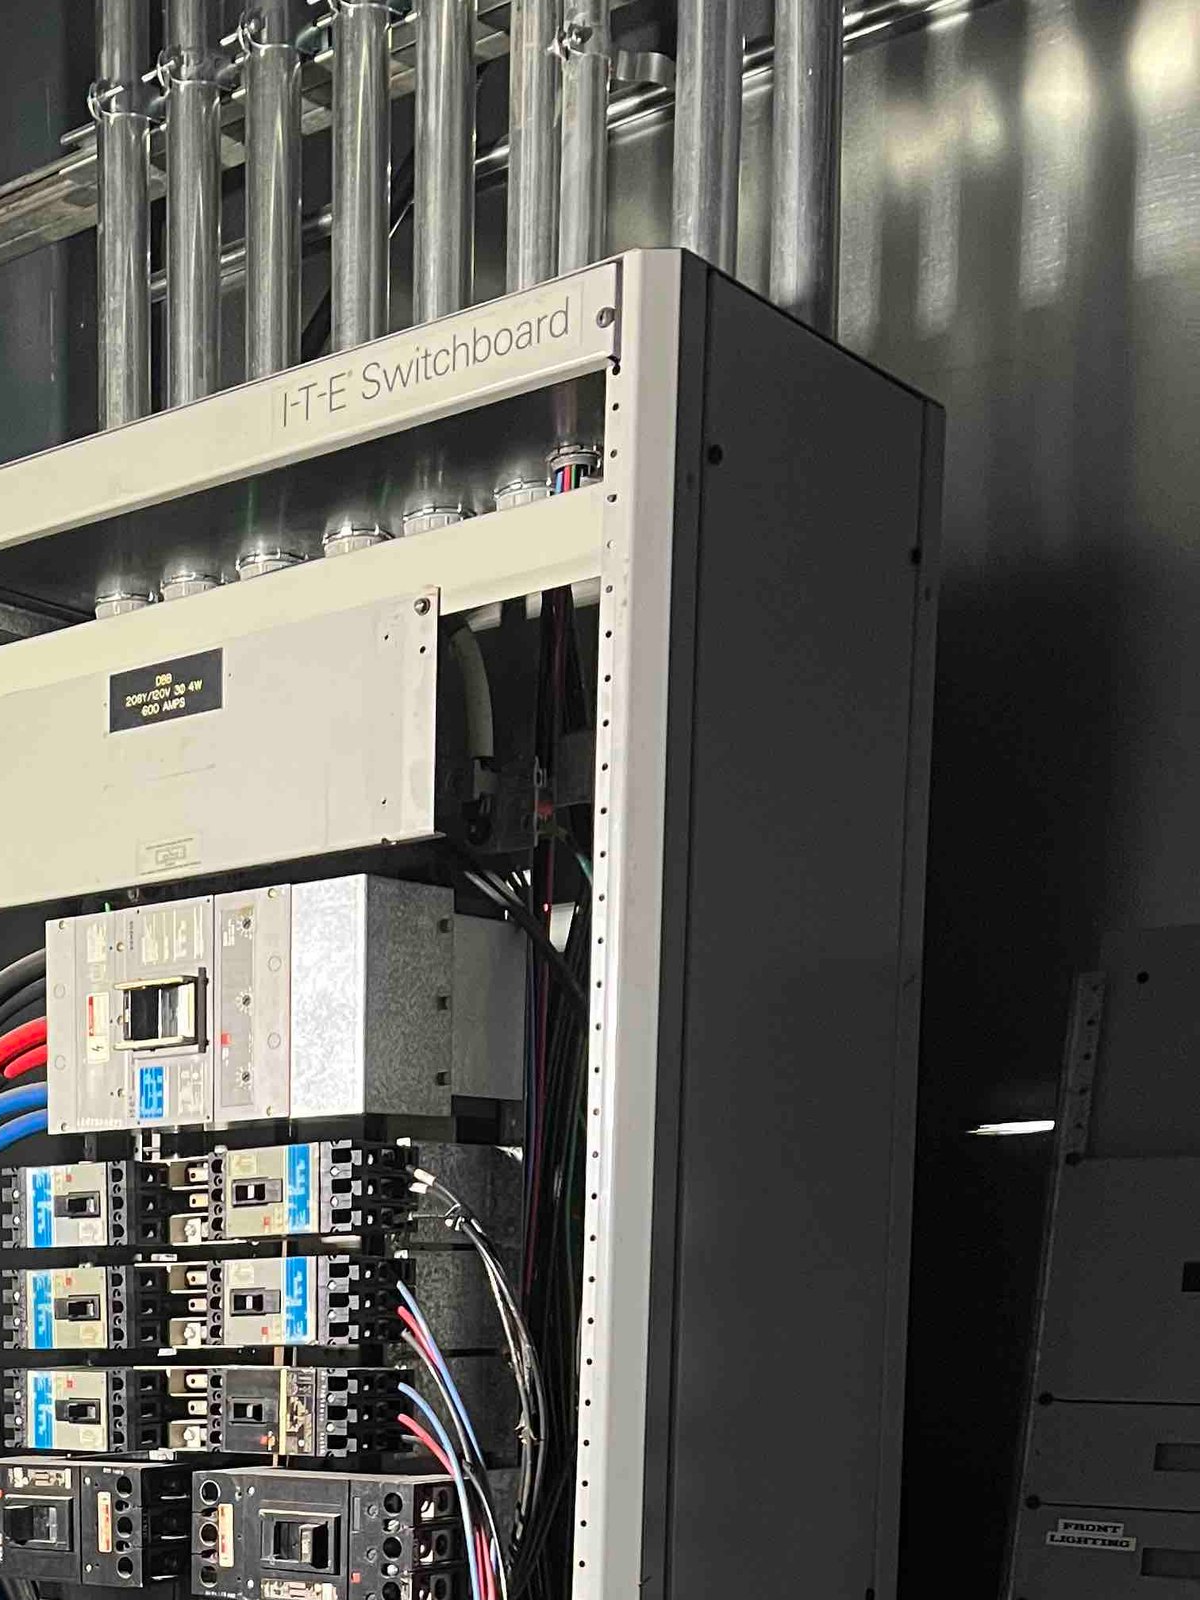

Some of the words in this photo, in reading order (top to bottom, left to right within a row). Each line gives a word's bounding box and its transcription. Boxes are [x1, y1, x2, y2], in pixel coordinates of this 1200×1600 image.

[362, 296, 569, 400] Switchboard
[188, 679, 203, 692] 4W
[141, 703, 160, 717] 600
[162, 696, 186, 712] AMPS
[1063, 1521, 1121, 1534] FRONT
[1049, 1534, 1130, 1548] LIGHTING
